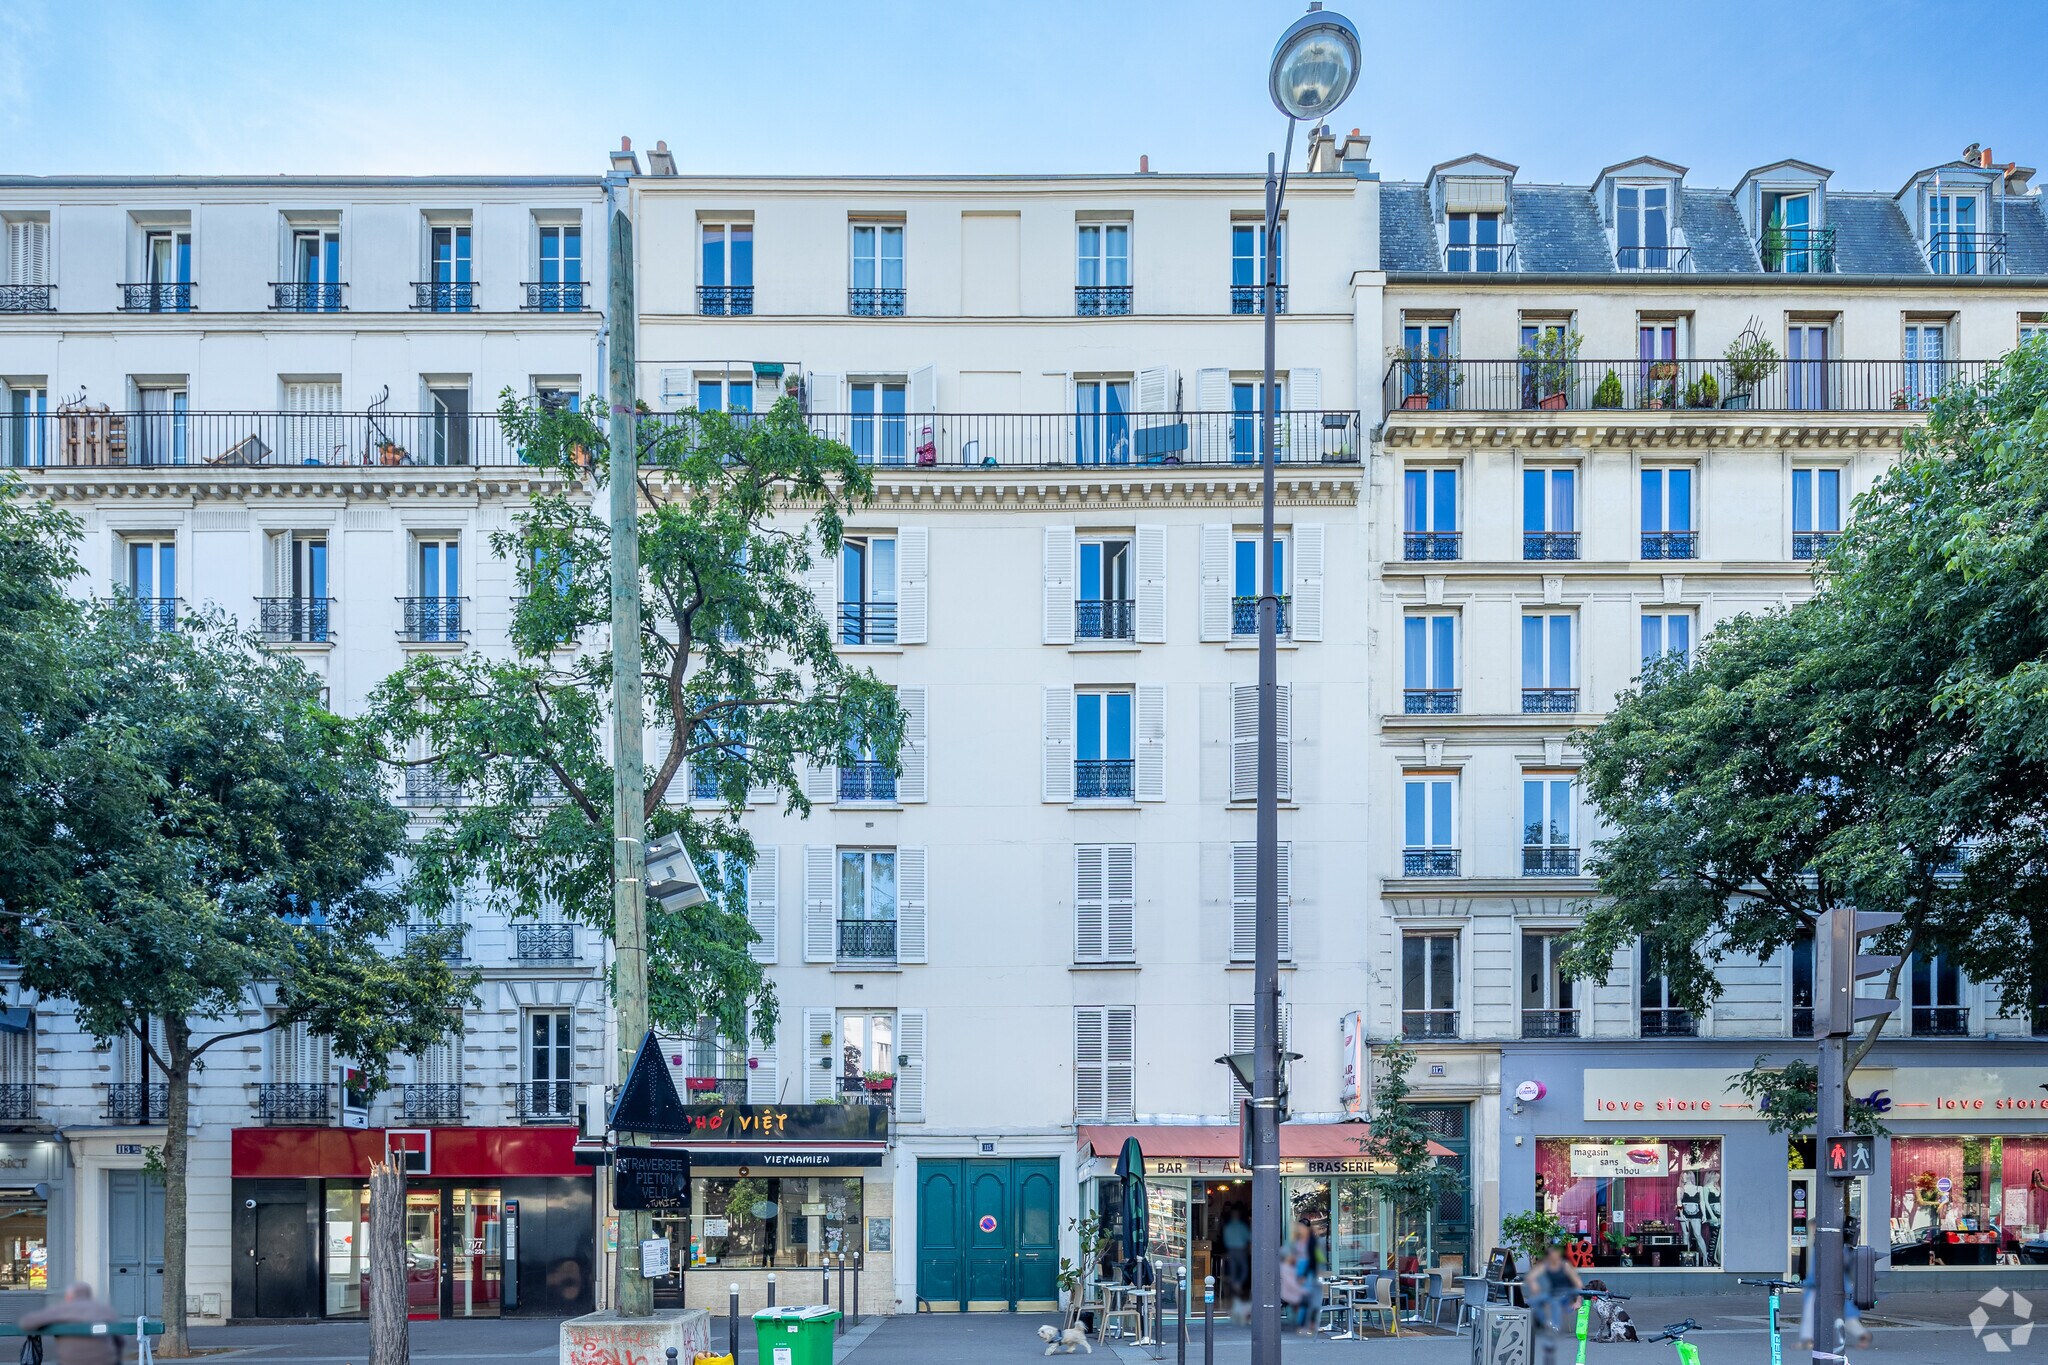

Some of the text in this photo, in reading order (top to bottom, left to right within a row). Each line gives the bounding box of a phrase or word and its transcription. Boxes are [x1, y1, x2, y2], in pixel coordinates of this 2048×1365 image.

[1432, 1066, 1443, 1074] 117
[1597, 1099, 1713, 1111] love store
[1937, 1097, 2048, 1109] love store
[118, 1145, 131, 1154] 113
[1574, 1147, 1609, 1158] magasin
[626, 1158, 683, 1171] TRAVERSEE
[764, 1155, 830, 1164] VIETNAMIEN
[1600, 1158, 1619, 1166] sans
[1157, 1162, 1183, 1174] BAR
[1309, 1161, 1375, 1172] BRASSERIE
[1615, 1166, 1640, 1175] tabou
[636, 1173, 674, 1185] PIETON
